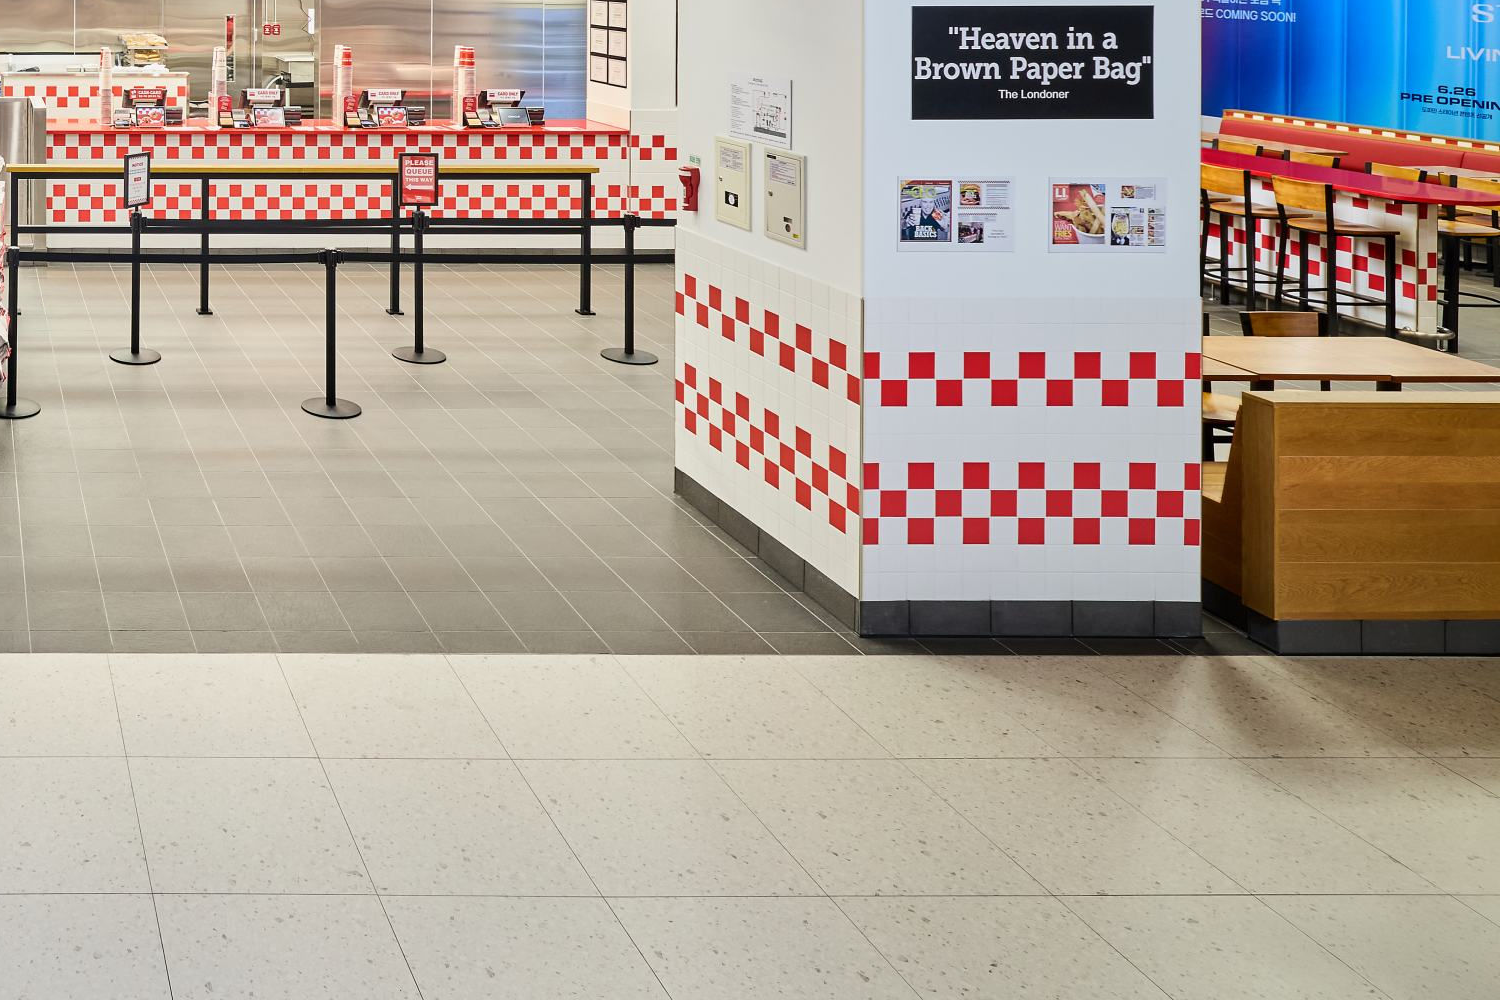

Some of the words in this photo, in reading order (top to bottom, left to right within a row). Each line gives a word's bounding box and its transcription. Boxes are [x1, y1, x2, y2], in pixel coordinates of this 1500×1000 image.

[1215, 8, 1258, 21] COMING
[1260, 10, 1296, 23] SOON!
[1471, 3, 1500, 23] S
[948, 26, 1058, 50] "Heaven
[1066, 26, 1094, 50] in
[1102, 32, 1118, 50] a
[914, 56, 1001, 80] Brown
[1009, 56, 1085, 85] Paper
[1092, 56, 1151, 85] Bag"
[998, 89, 1018, 99] The
[1021, 89, 1070, 99] Londoner
[1400, 92, 1433, 104] PRE
[1438, 85, 1476, 97] 6.26
